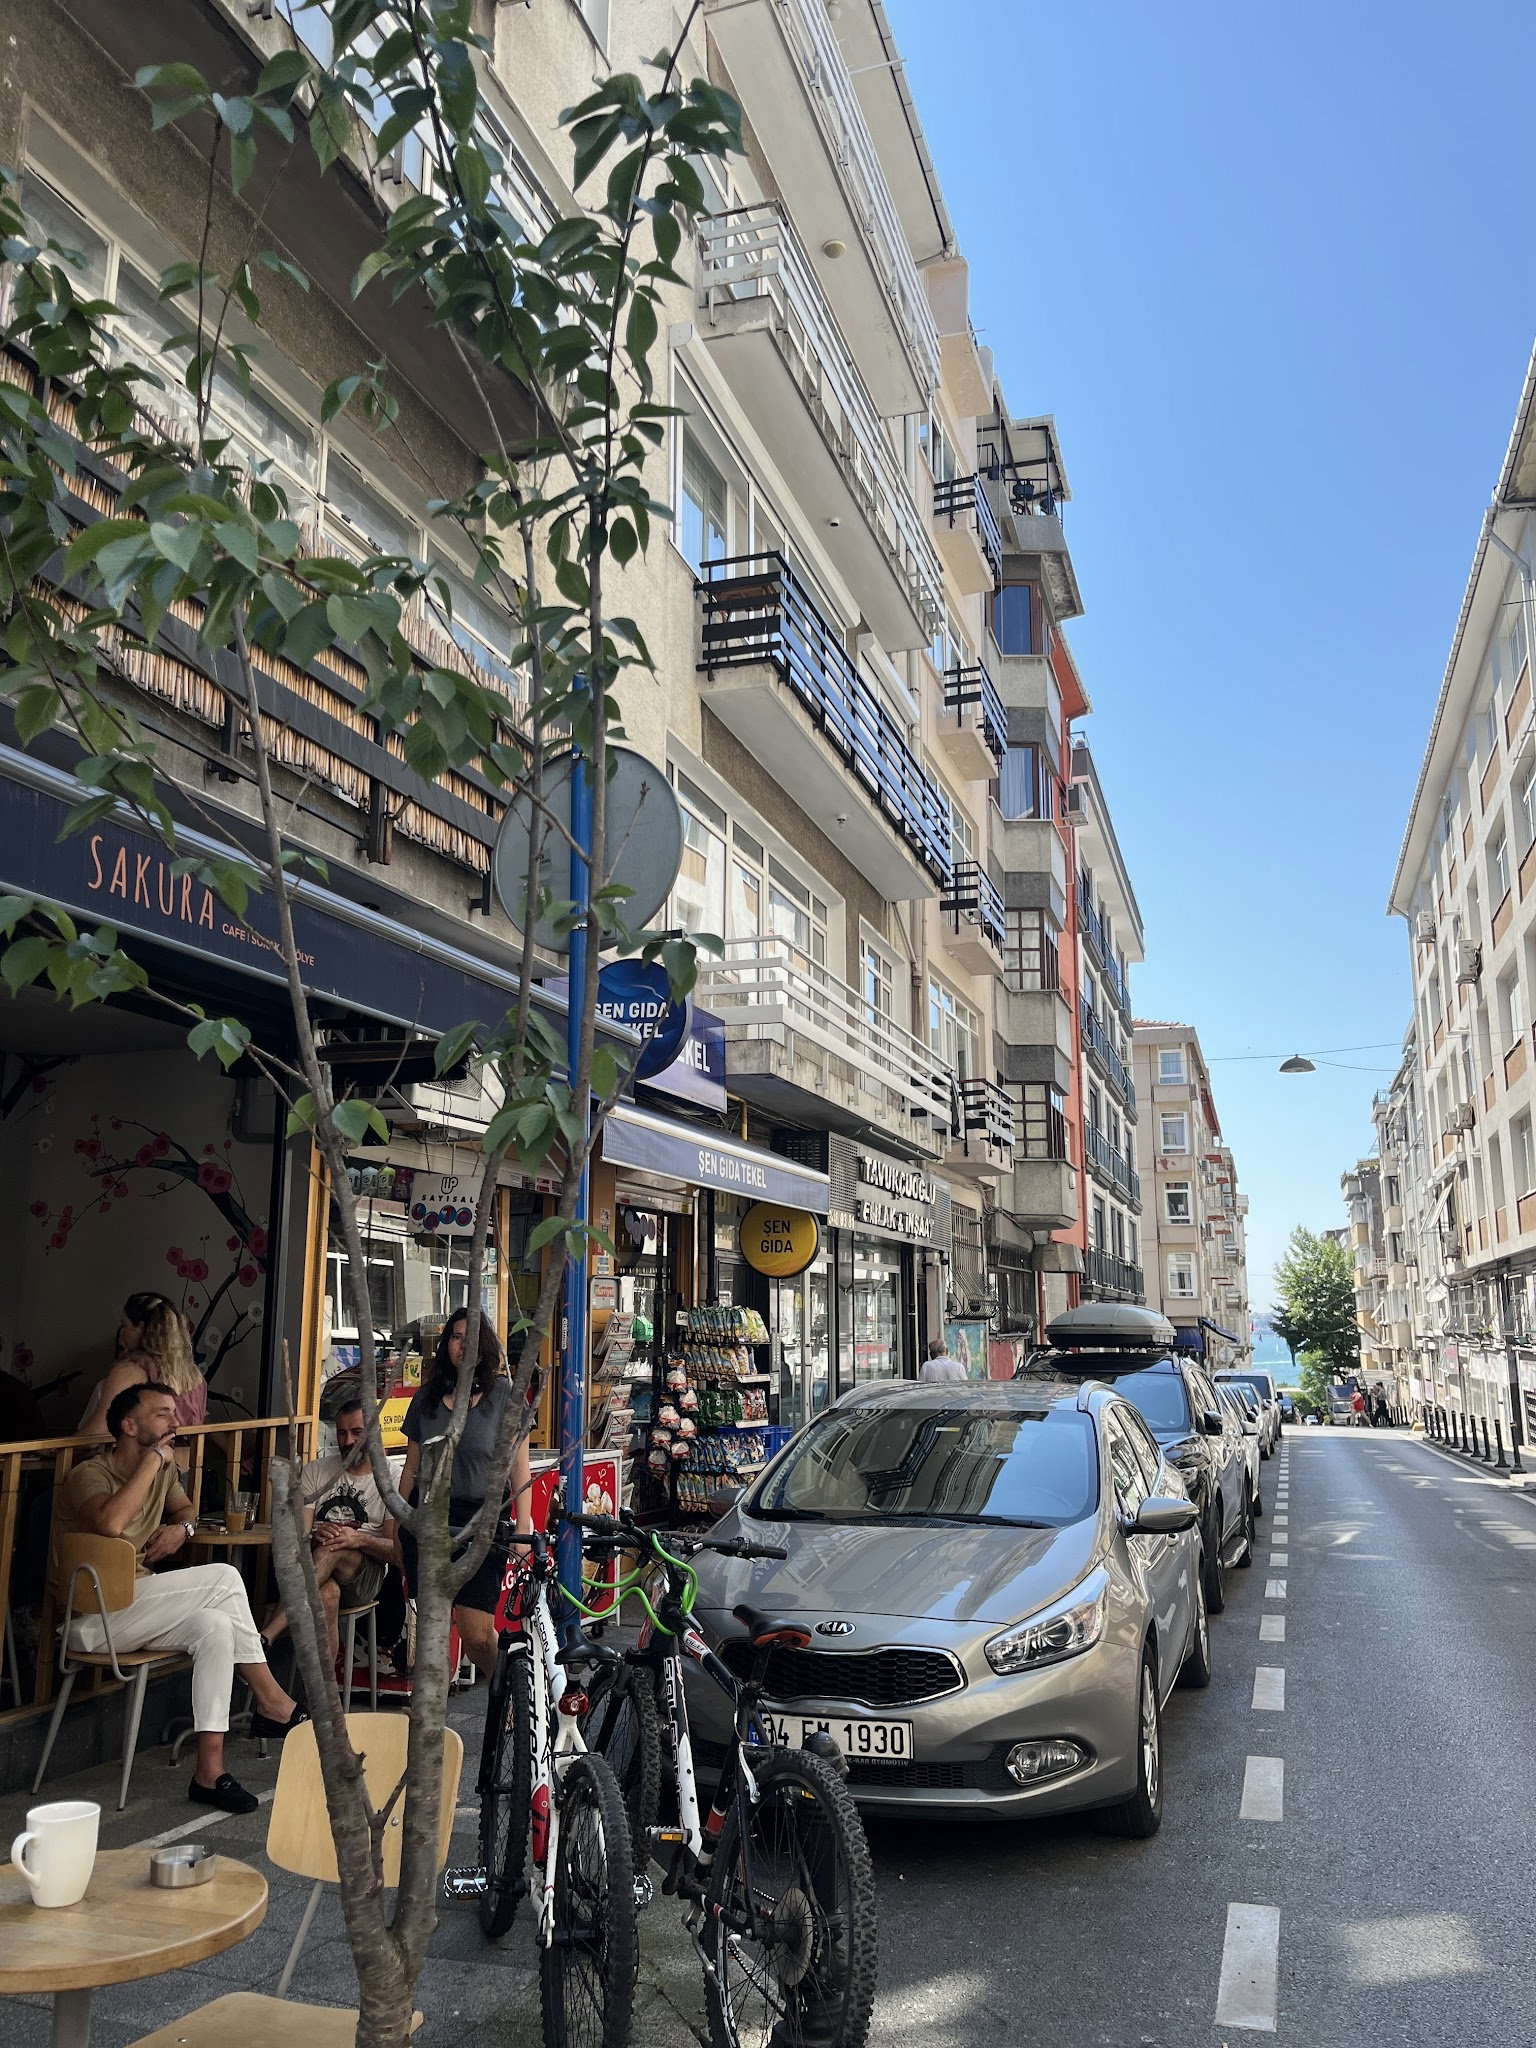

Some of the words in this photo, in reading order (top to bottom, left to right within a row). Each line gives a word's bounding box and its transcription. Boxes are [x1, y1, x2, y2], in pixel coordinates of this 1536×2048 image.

[87, 835, 214, 929] SAKURA
[222, 923, 246, 941] CAFE
[295, 948, 315, 967] ÖLYE
[629, 1002, 670, 1018] GIDA
[623, 1022, 664, 1039] KEL
[677, 1039, 711, 1073] KEL
[698, 1150, 718, 1178] ŞEN
[720, 1156, 741, 1183] GIDA
[741, 1163, 767, 1189] TEKEL
[421, 1194, 474, 1204] SAYISAL
[763, 1220, 791, 1237] ŞEN
[761, 1239, 794, 1253] GIDA
[535, 1607, 550, 1653] ALCON
[820, 1621, 848, 1632] KIA
[762, 1717, 790, 1746] 34
[844, 1723, 905, 1755] 1930
